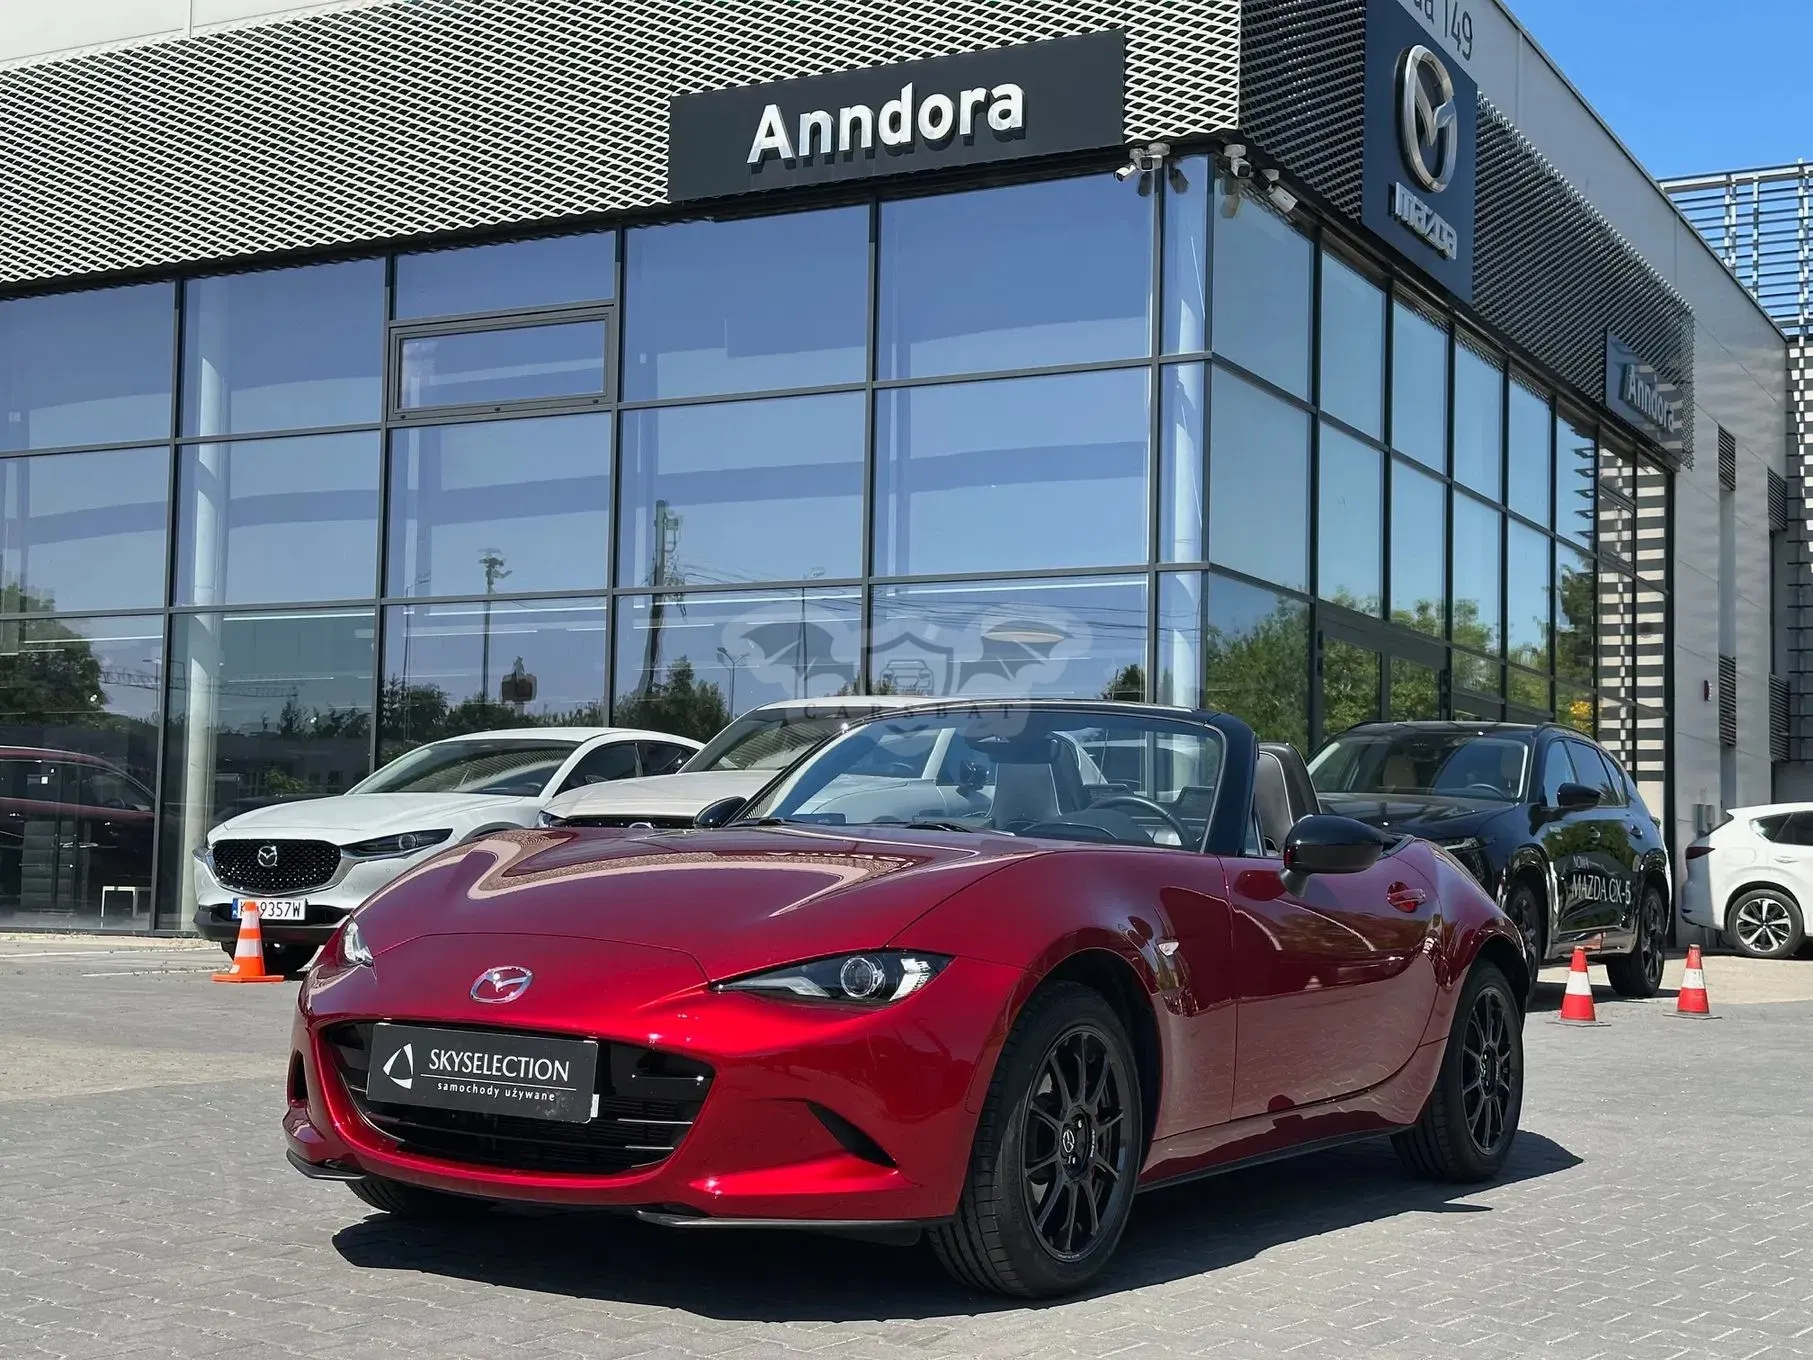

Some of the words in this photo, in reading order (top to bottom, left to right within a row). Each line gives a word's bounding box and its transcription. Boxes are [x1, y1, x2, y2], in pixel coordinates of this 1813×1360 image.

[747, 82, 1025, 164] Anndora
[1571, 874, 1607, 901] MAZDA
[1608, 878, 1631, 904] CX-5
[429, 1049, 569, 1082] SKYSELECTION
[437, 1082, 500, 1098] samochody
[505, 1087, 555, 1101] używane
